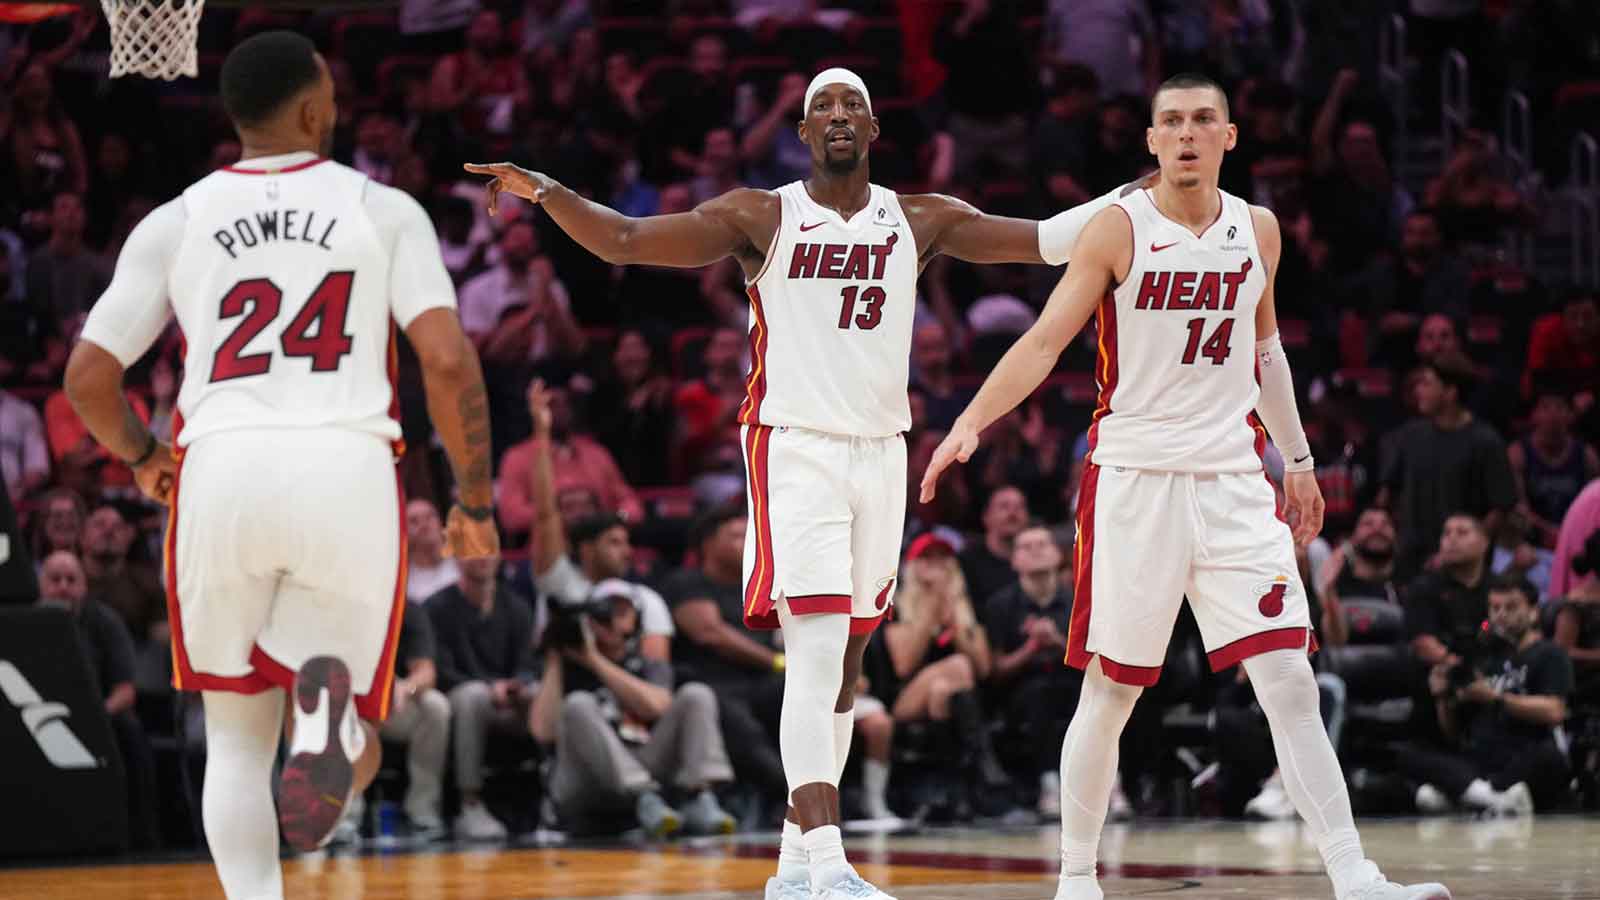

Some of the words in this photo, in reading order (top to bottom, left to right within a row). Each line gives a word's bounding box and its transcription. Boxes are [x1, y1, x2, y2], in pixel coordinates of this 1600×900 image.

[213, 210, 338, 259] POWELL
[788, 231, 899, 280] HEAT
[838, 285, 887, 330] 13
[1135, 256, 1253, 310] HEAT
[209, 270, 356, 383] 24
[1181, 317, 1236, 365] 14
